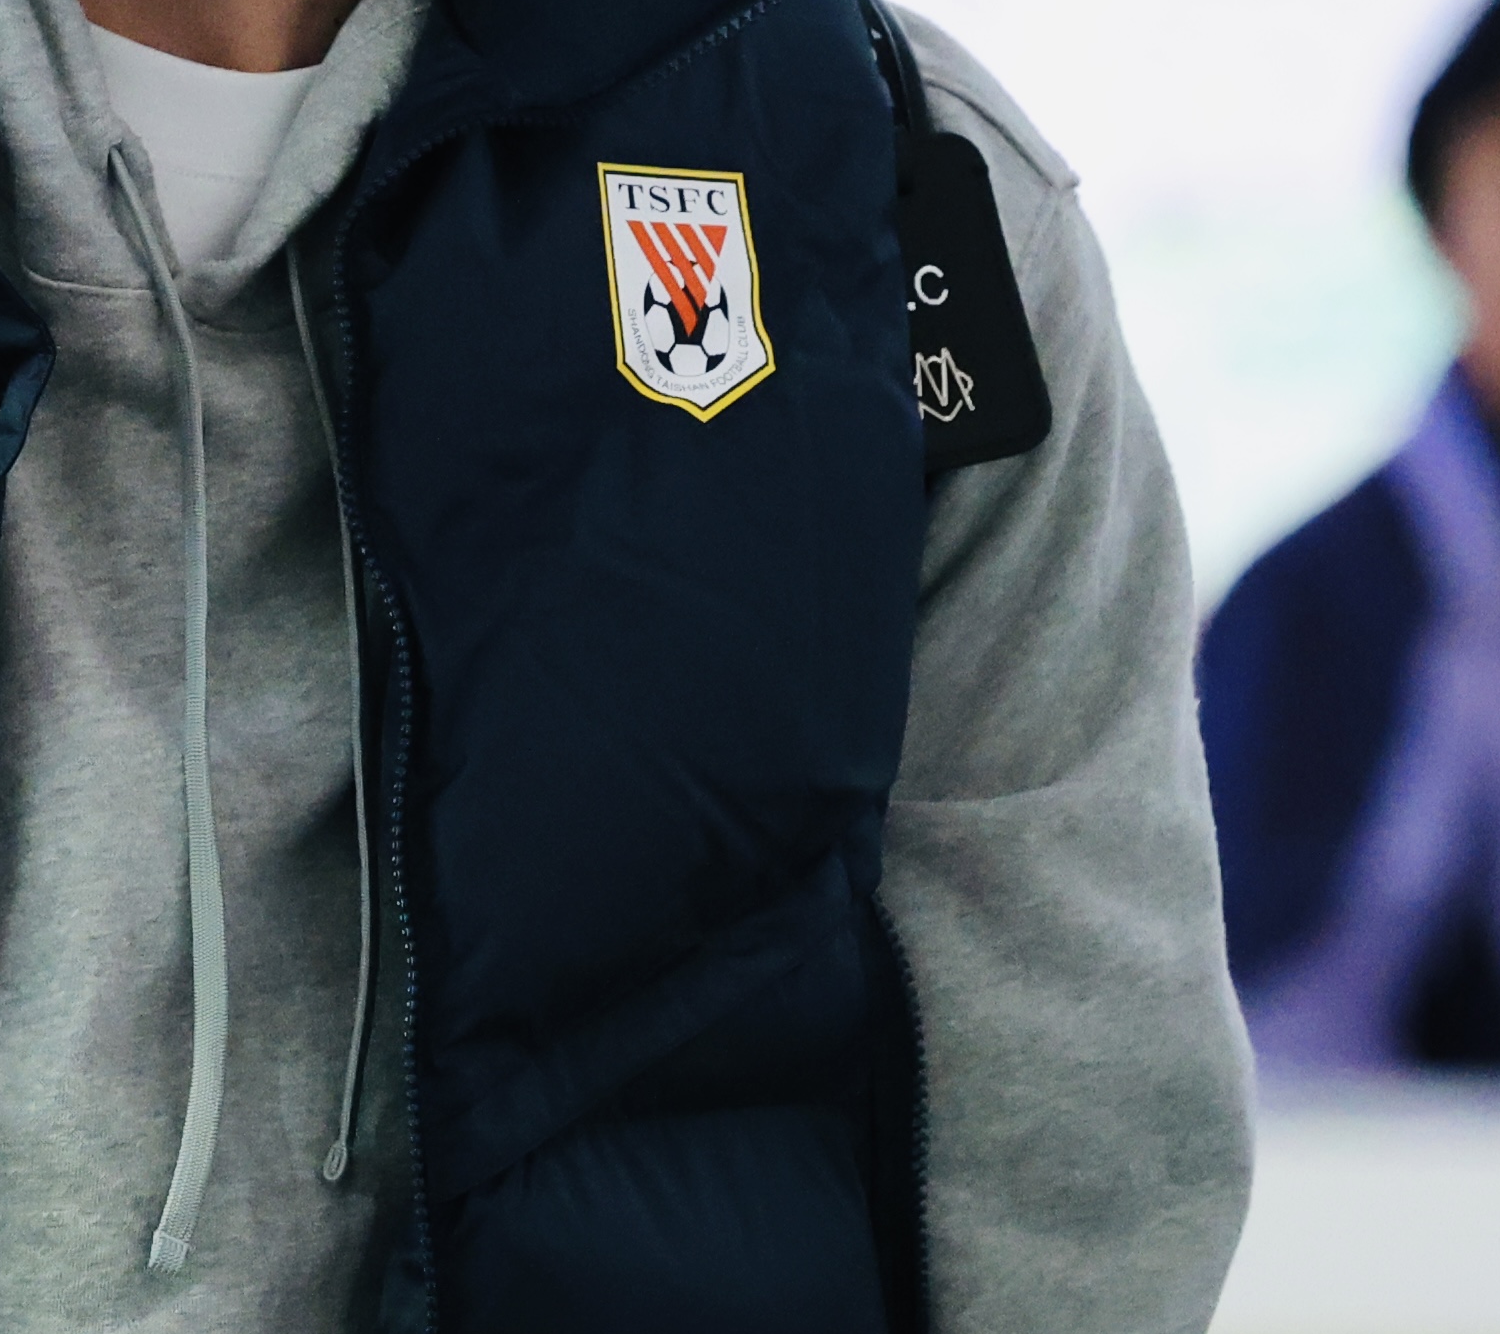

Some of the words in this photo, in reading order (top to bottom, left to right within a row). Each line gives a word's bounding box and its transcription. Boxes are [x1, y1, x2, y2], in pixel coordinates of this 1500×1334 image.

[617, 182, 729, 216] TSFC
[906, 264, 949, 312] .C
[627, 307, 655, 380] SHANDONG
[656, 376, 710, 392] TAISHAN
[710, 350, 749, 388] FOOTBALL
[735, 315, 750, 348] CLUB
